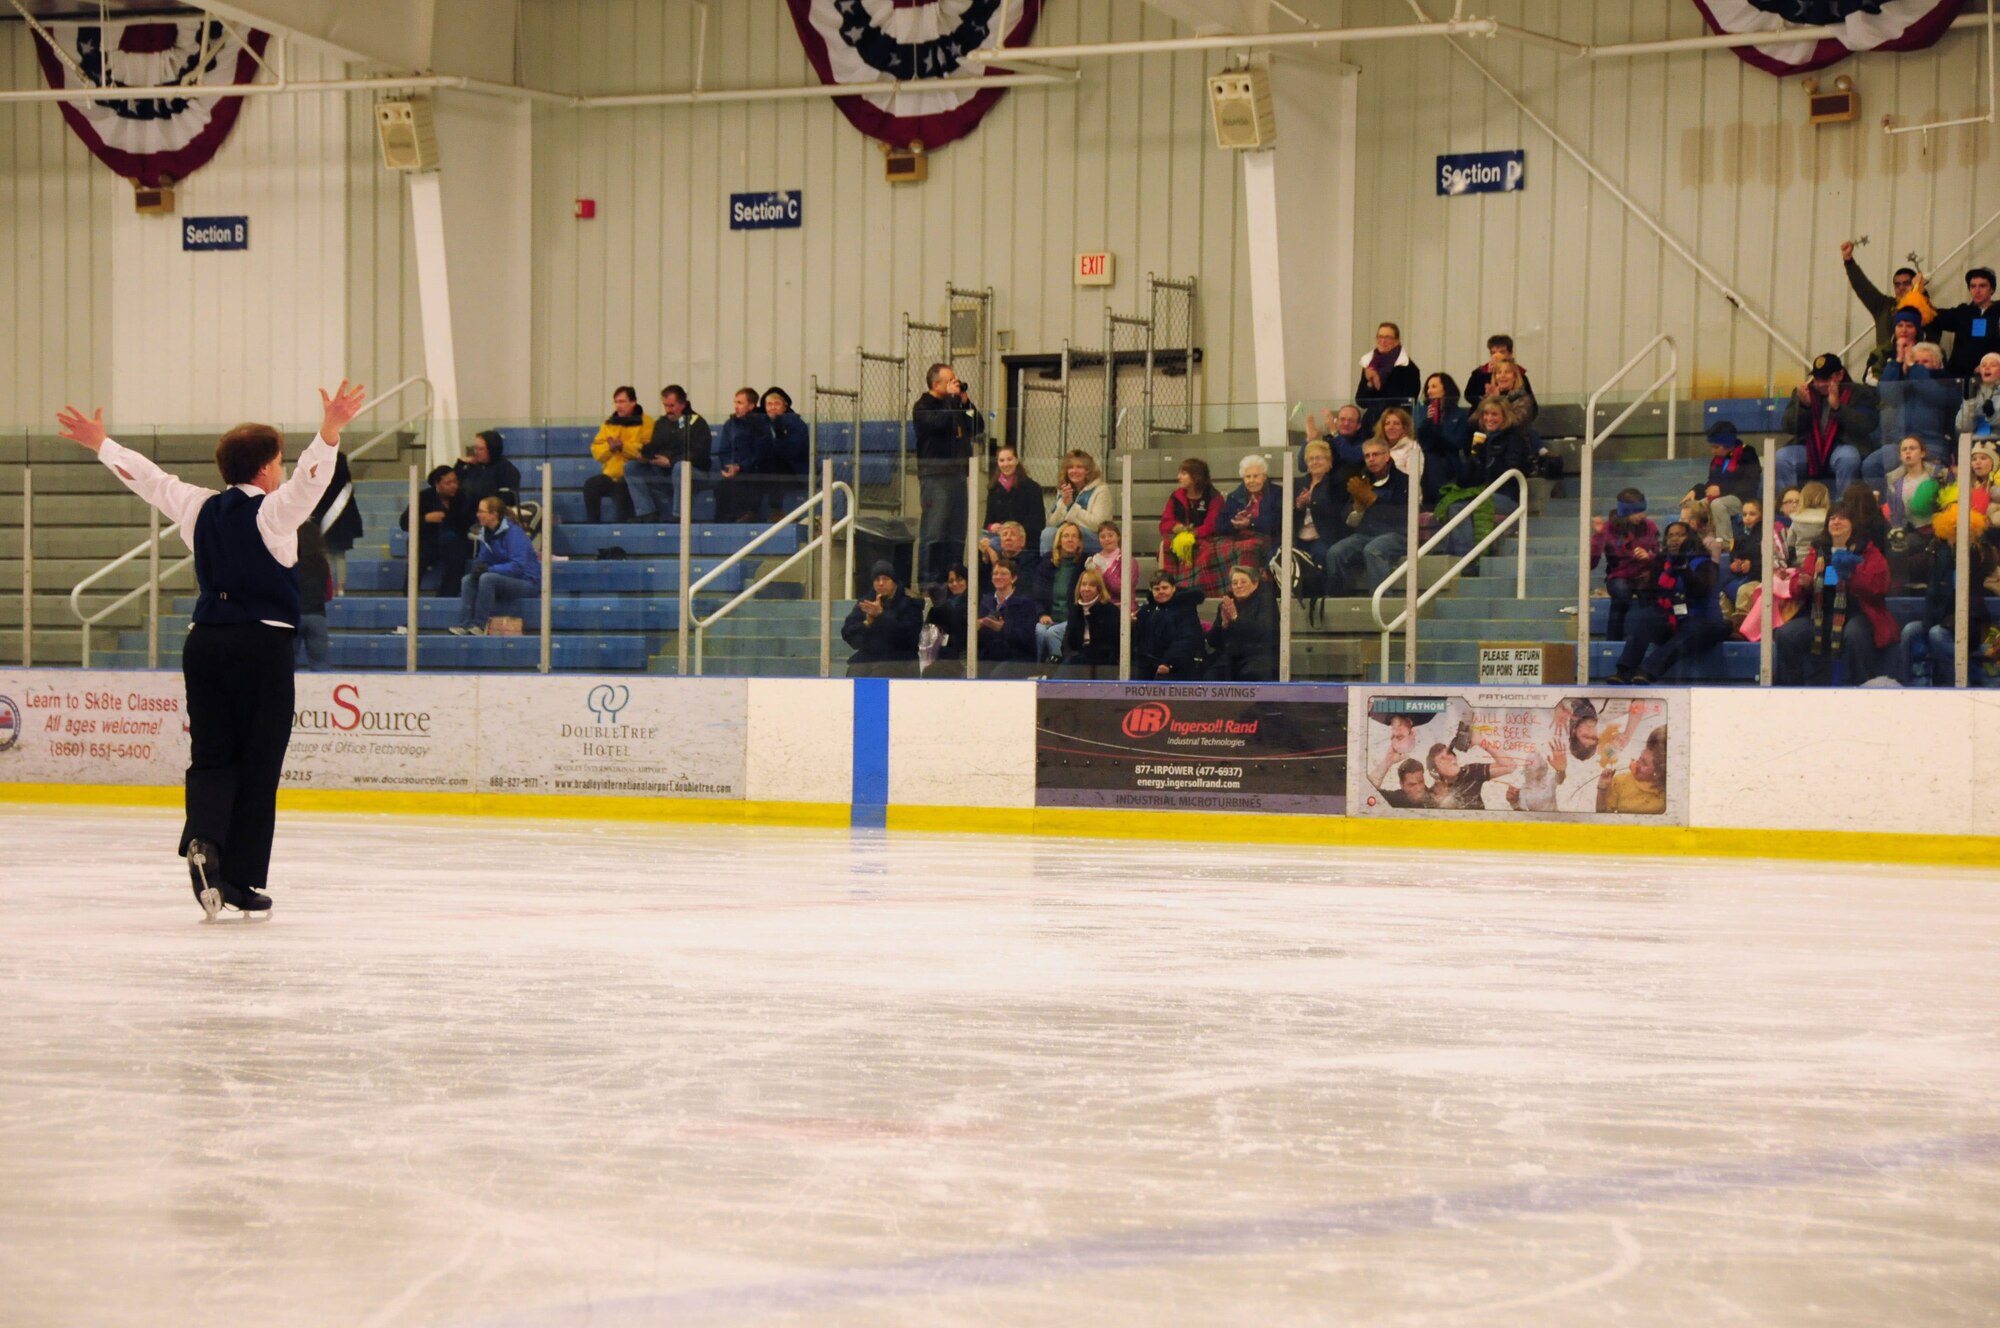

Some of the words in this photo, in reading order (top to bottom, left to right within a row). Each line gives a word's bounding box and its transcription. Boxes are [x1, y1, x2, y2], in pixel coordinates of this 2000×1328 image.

[734, 200, 783, 222] Section
[787, 199, 798, 219] C
[186, 224, 231, 244] Section
[235, 223, 244, 242] B
[1081, 255, 1105, 275] EXIT
[1483, 650, 1509, 661] PLEASE
[1514, 650, 1540, 661] RETURN
[1482, 664, 1495, 676] POM
[1496, 664, 1512, 676] POMS
[1517, 664, 1539, 676] HERE
[1125, 686, 1166, 697] PROVEN
[1169, 686, 1208, 698] ENERGY
[1211, 687, 1256, 698] SAVINGS
[26, 690, 61, 708] Learn
[67, 693, 79, 708] to
[85, 692, 122, 710] Sk8te
[128, 693, 178, 712] Classes
[291, 684, 431, 732] ocuSource
[1406, 702, 1445, 711] FATHOM
[45, 715, 61, 732] All
[65, 719, 96, 736] ages
[102, 717, 163, 735] welcome!
[1130, 708, 1162, 732] IR
[1472, 712, 1500, 724] WILL
[1505, 712, 1541, 726] WORK
[1170, 720, 1223, 735] Ingersoll
[1225, 720, 1258, 734] Rand
[321, 741, 333, 753] of
[370, 742, 430, 758] Technology
[1167, 736, 1200, 746] Industrial
[1201, 737, 1245, 748] Technologies
[51, 742, 85, 758] (860)
[90, 743, 151, 759] 651-5400
[583, 743, 631, 757] HOTEL
[1135, 765, 1194, 776] 877-IRPOWER
[1195, 766, 1242, 778] (477-6937)
[1137, 778, 1240, 789] energy.ingersollrand.com
[1116, 794, 1176, 807] INDUSTRIAL
[1180, 796, 1262, 809] MICROTURBINES
